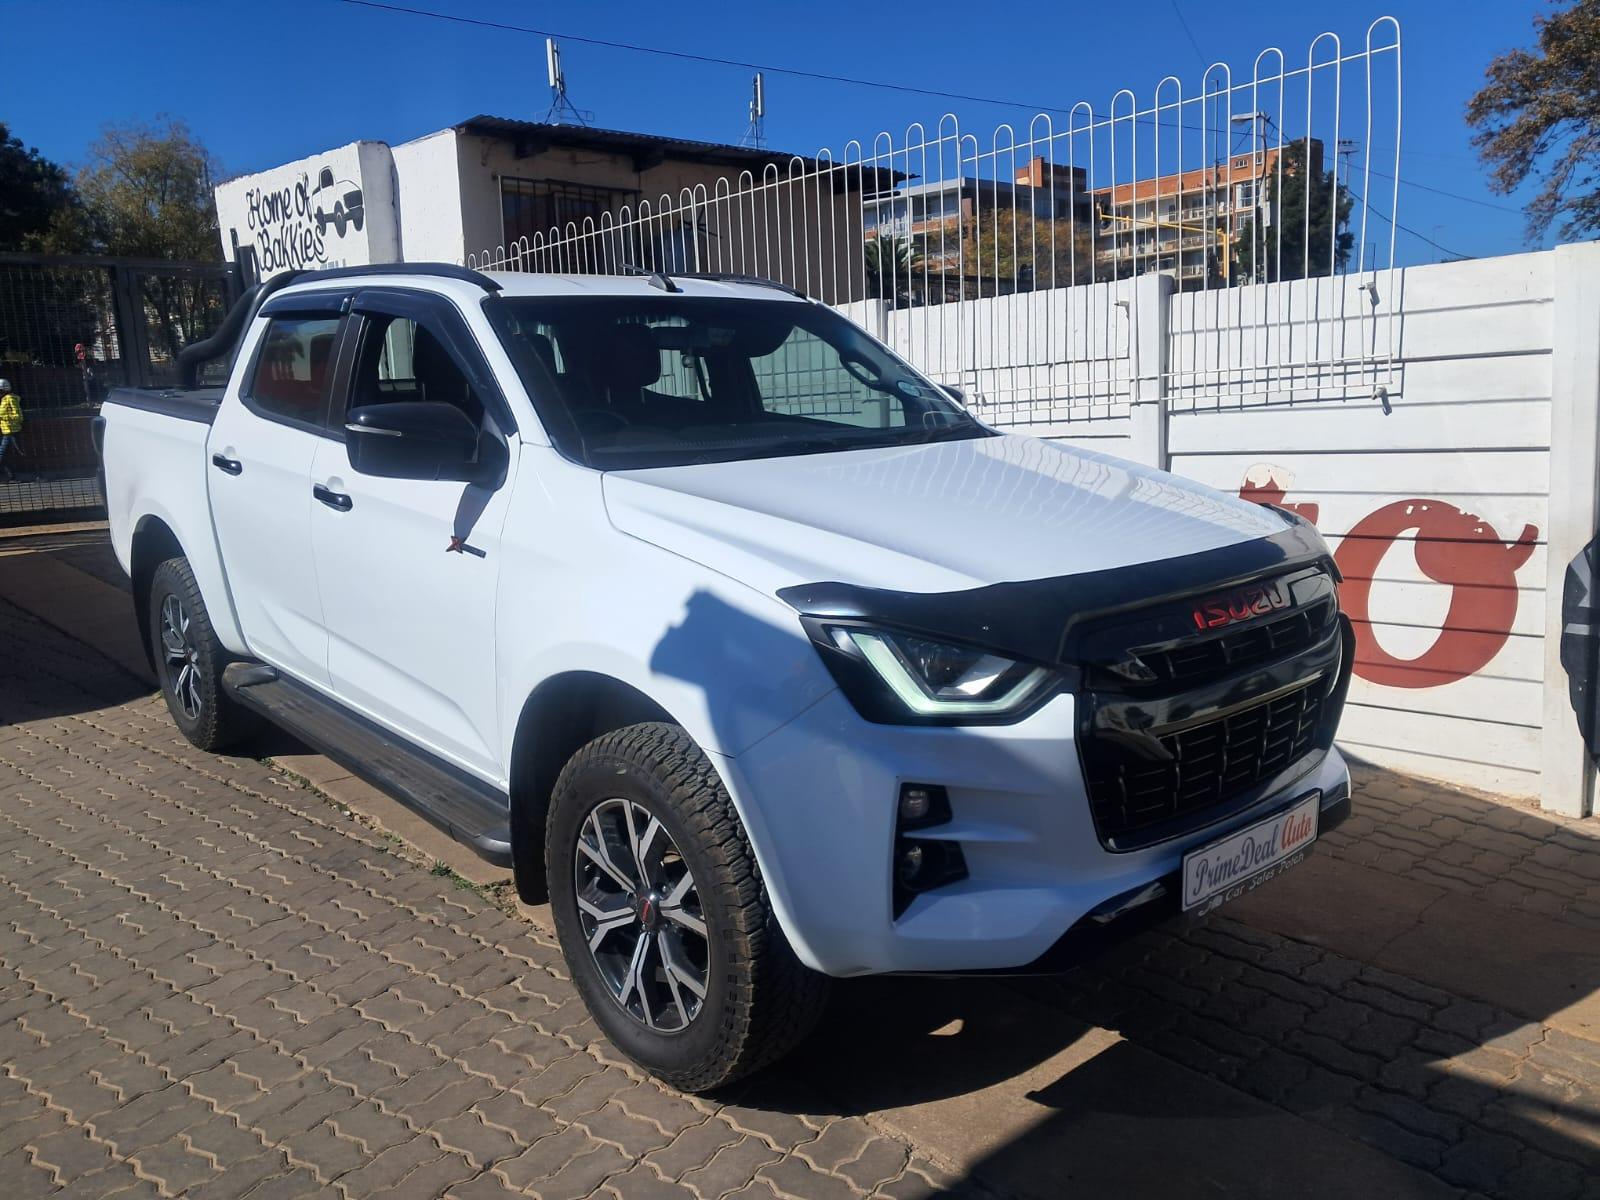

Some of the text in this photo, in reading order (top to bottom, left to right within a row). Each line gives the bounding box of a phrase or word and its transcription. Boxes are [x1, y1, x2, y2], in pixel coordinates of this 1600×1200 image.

[246, 187, 293, 230] Home
[1193, 577, 1292, 630] ISUZU
[1281, 812, 1311, 850] Auto
